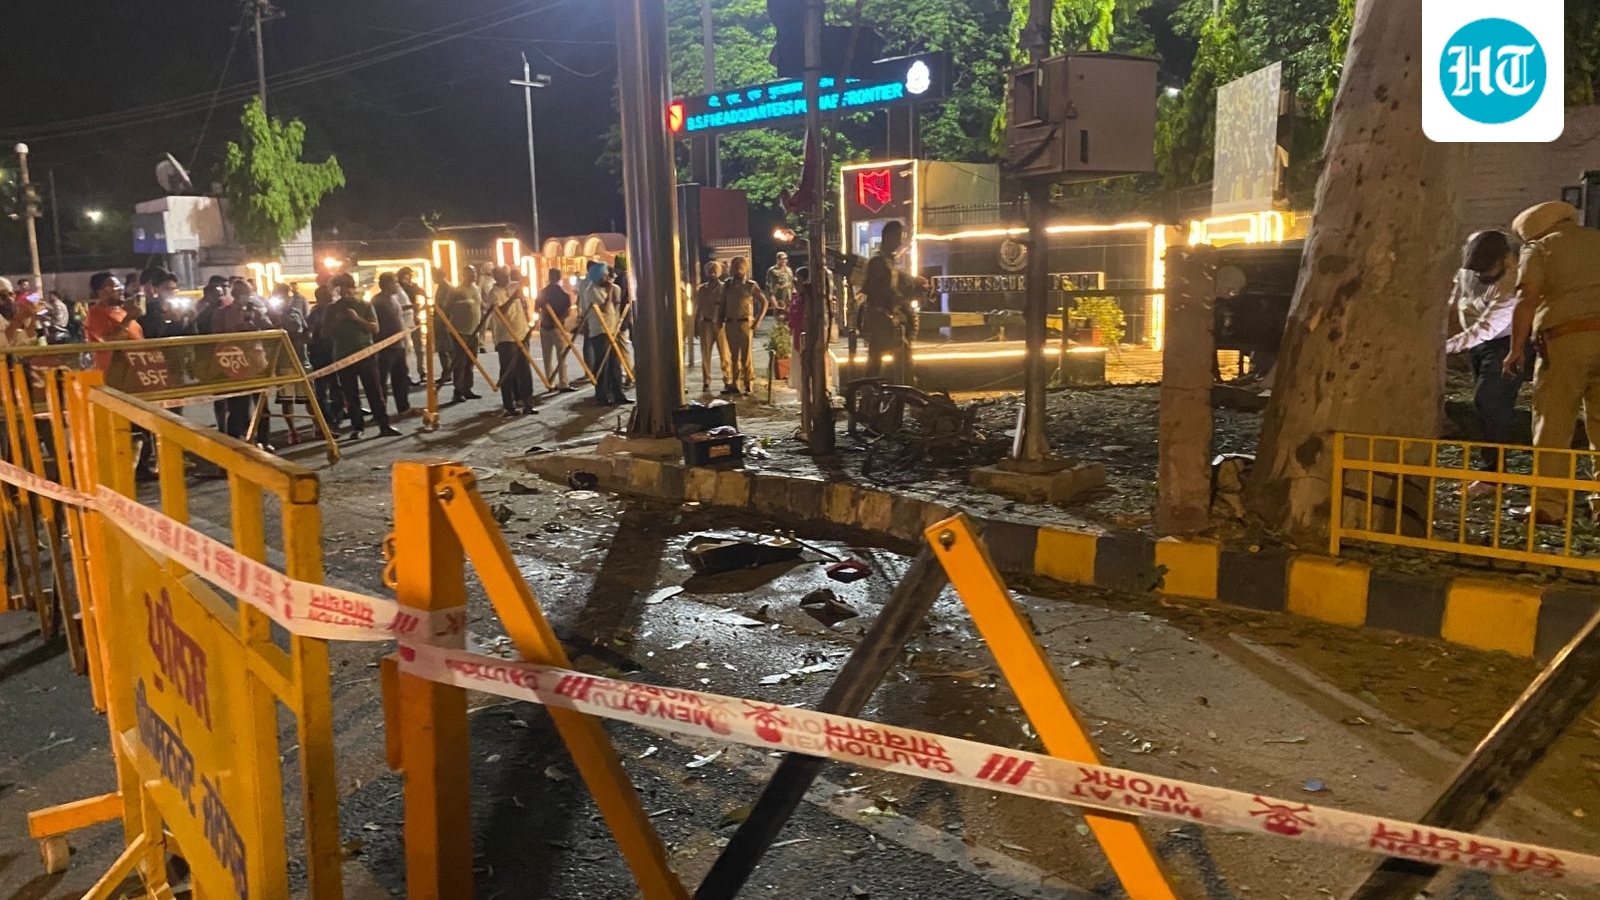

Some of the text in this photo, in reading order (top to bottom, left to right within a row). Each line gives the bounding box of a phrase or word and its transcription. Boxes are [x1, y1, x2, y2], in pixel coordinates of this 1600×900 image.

[709, 100, 793, 128] HEADQUARTERS
[841, 81, 905, 108] FRONTIER
[137, 369, 168, 387] BSF
[823, 717, 950, 759] सावधान
[826, 734, 956, 775] CAUTION
[1070, 783, 1204, 819] MEN AT
[1080, 766, 1188, 802] WORK
[1371, 822, 1565, 868] सावधान
